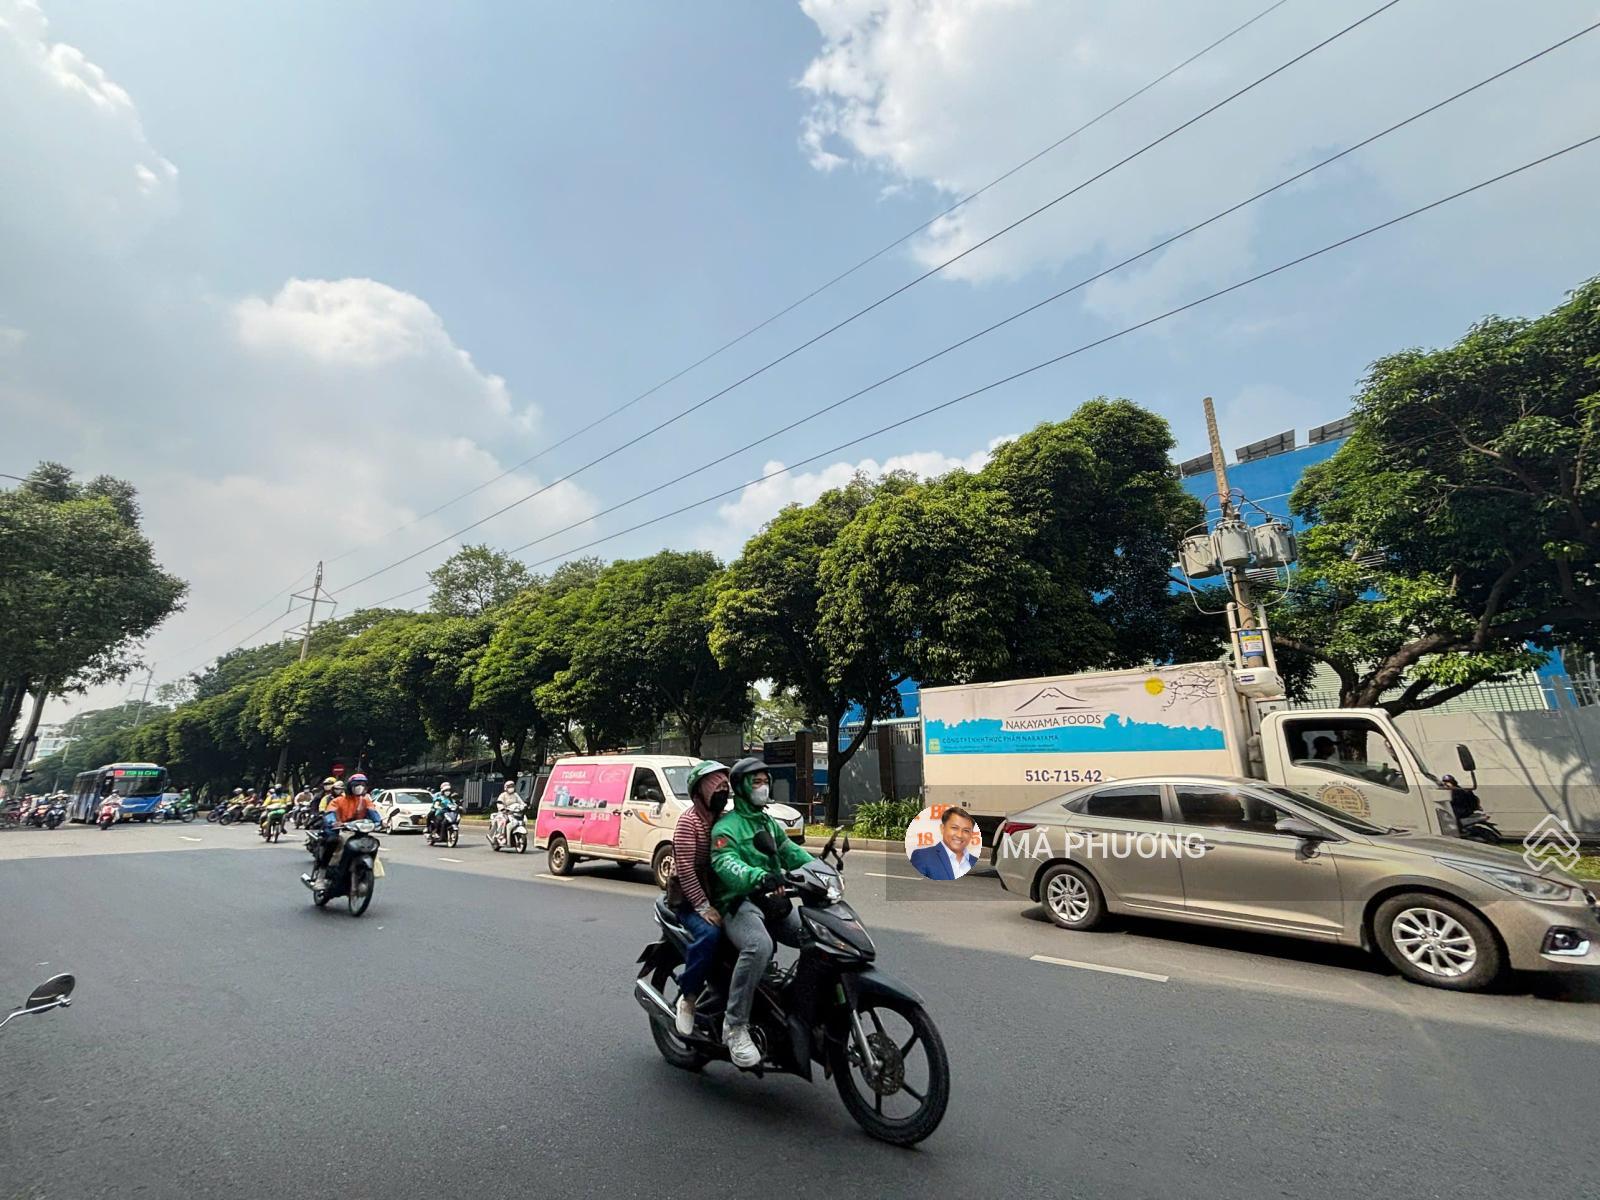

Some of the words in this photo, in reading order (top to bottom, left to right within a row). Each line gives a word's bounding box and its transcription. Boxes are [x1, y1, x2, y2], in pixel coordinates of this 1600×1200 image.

[1006, 718, 1059, 730] NAKAYAMA
[1063, 714, 1101, 725] FOODS
[1025, 769, 1102, 783] 51C-715.42
